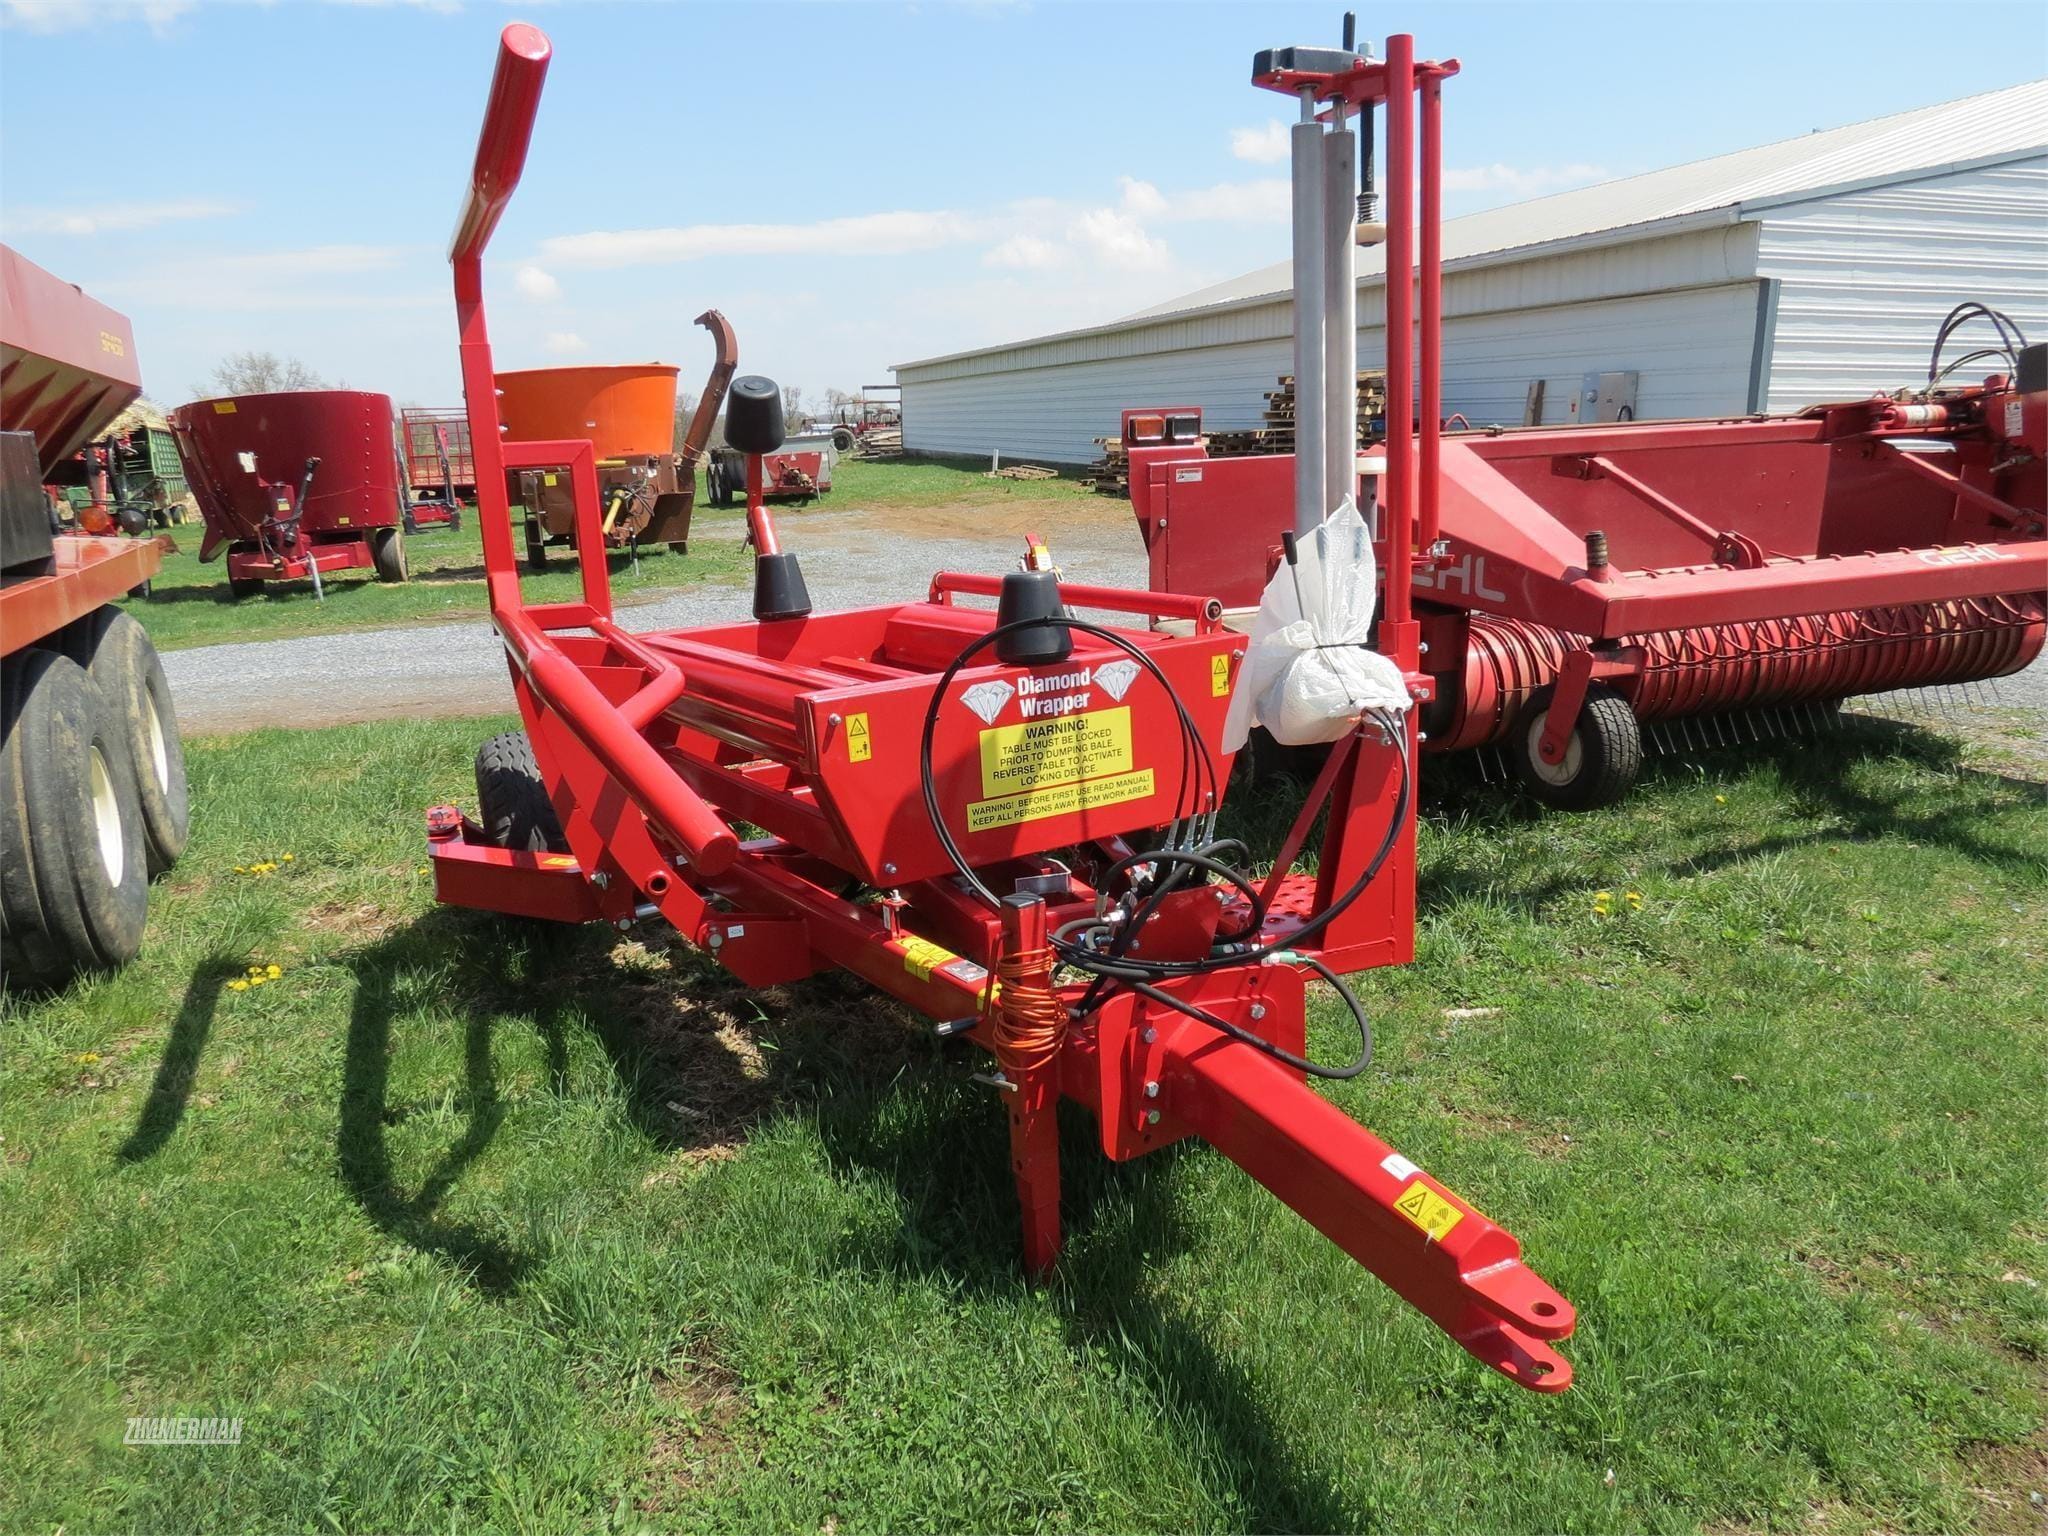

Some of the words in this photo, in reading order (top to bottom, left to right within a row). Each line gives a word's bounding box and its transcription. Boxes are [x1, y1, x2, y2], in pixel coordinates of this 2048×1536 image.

[1918, 547, 2018, 565] GEHL
[1017, 667, 1091, 697] Diamond
[1019, 692, 1091, 718] Wrapper
[1002, 743, 1031, 755] TABLE
[1033, 738, 1060, 750] MUST
[1061, 735, 1074, 745] BE
[1076, 728, 1112, 743] LOCKED
[1025, 719, 1089, 740] WARNING!
[993, 765, 1036, 780] REVERSE
[1038, 759, 1066, 771] TABLE
[1067, 756, 1080, 766] TO
[1081, 748, 1123, 763] ACTIVATE
[1000, 755, 1029, 767] PRIOR
[1031, 752, 1044, 762] TO
[1046, 744, 1088, 759] DUMPING
[1090, 739, 1115, 751] BALE.
[1020, 771, 1062, 786] LOCKING
[1064, 764, 1098, 778] DEVICE.
[971, 802, 1014, 816] WARNING!
[1018, 794, 1051, 808] BEFORE
[1052, 790, 1074, 801] FIRST
[1076, 786, 1092, 796] USE
[1093, 782, 1115, 793] READ
[1116, 775, 1150, 788] MANUAL!
[972, 815, 995, 827] KEEP
[997, 812, 1013, 822] ALL
[1014, 804, 1053, 819] PERSONS
[1054, 799, 1077, 811] AWAY
[1078, 795, 1100, 805] FROM
[1102, 789, 1126, 801] WORK
[1127, 784, 1150, 796] AREA!
